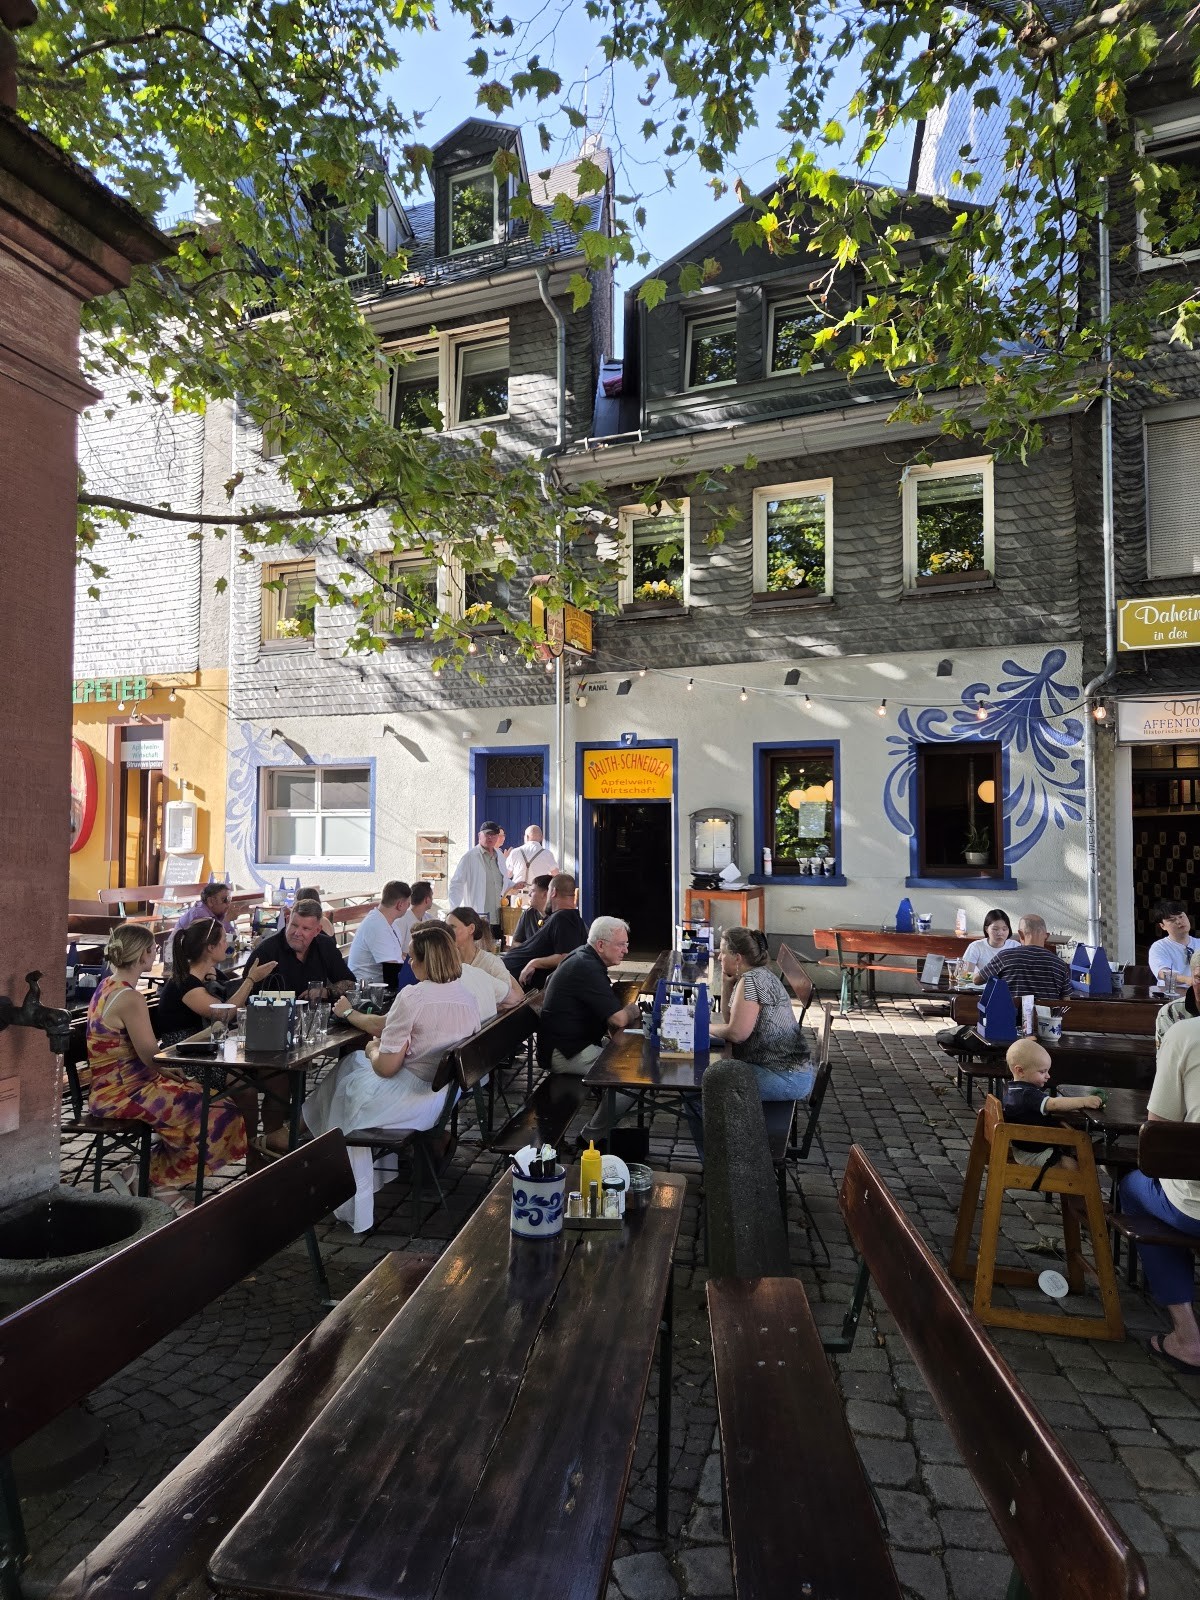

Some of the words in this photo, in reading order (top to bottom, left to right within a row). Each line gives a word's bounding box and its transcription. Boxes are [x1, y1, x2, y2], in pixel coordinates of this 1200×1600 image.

[1154, 631, 1164, 641] in
[1168, 626, 1188, 640] der
[1143, 717, 1200, 729] AFFENTO
[625, 734, 633, 745] 7
[588, 753, 669, 780] DAUTH-SCHNEIDER
[600, 778, 657, 787] Apfelwein-
[600, 786, 657, 794] Wirtschaft
